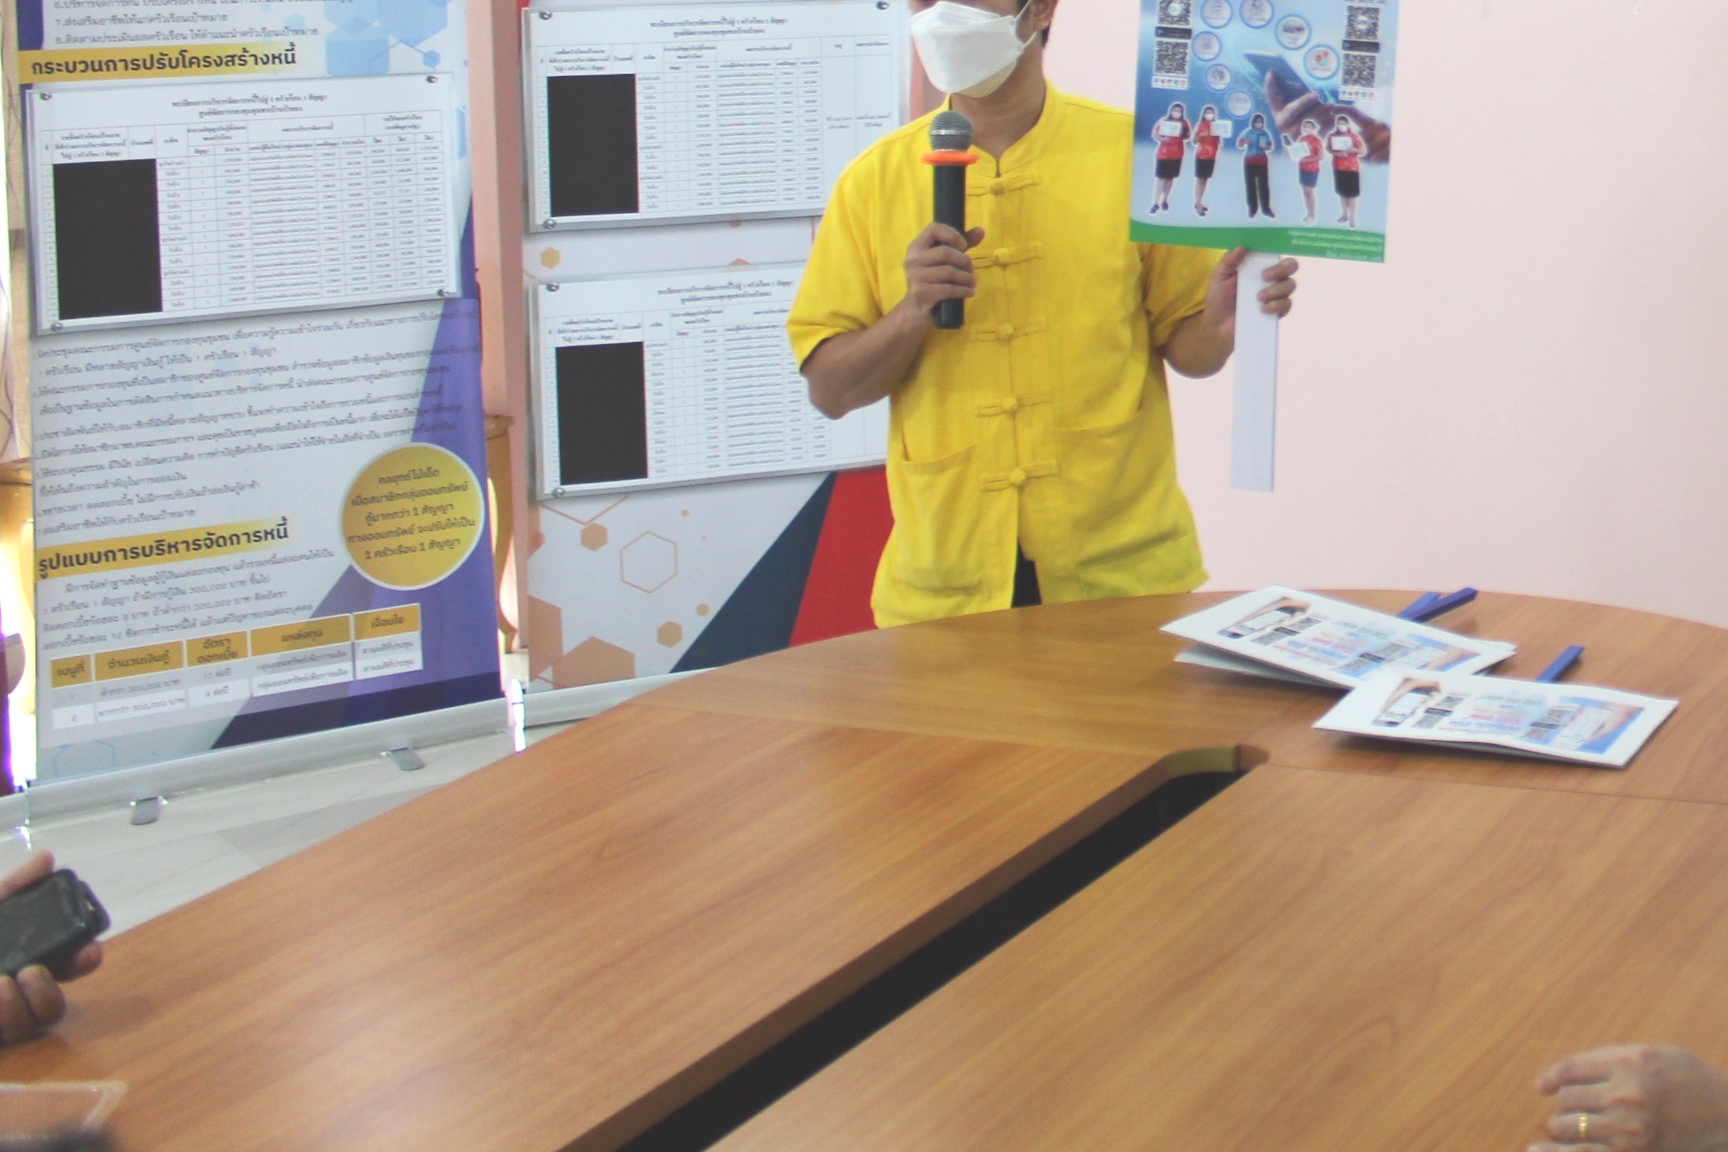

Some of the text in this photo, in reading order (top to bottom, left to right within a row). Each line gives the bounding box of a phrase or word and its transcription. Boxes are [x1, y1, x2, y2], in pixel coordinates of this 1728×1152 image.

[31, 42, 296, 75] กระบวนการปรับโครงสร้างหนี้
[38, 516, 290, 579] รูปแบบการบริหารจัดการหนี้
